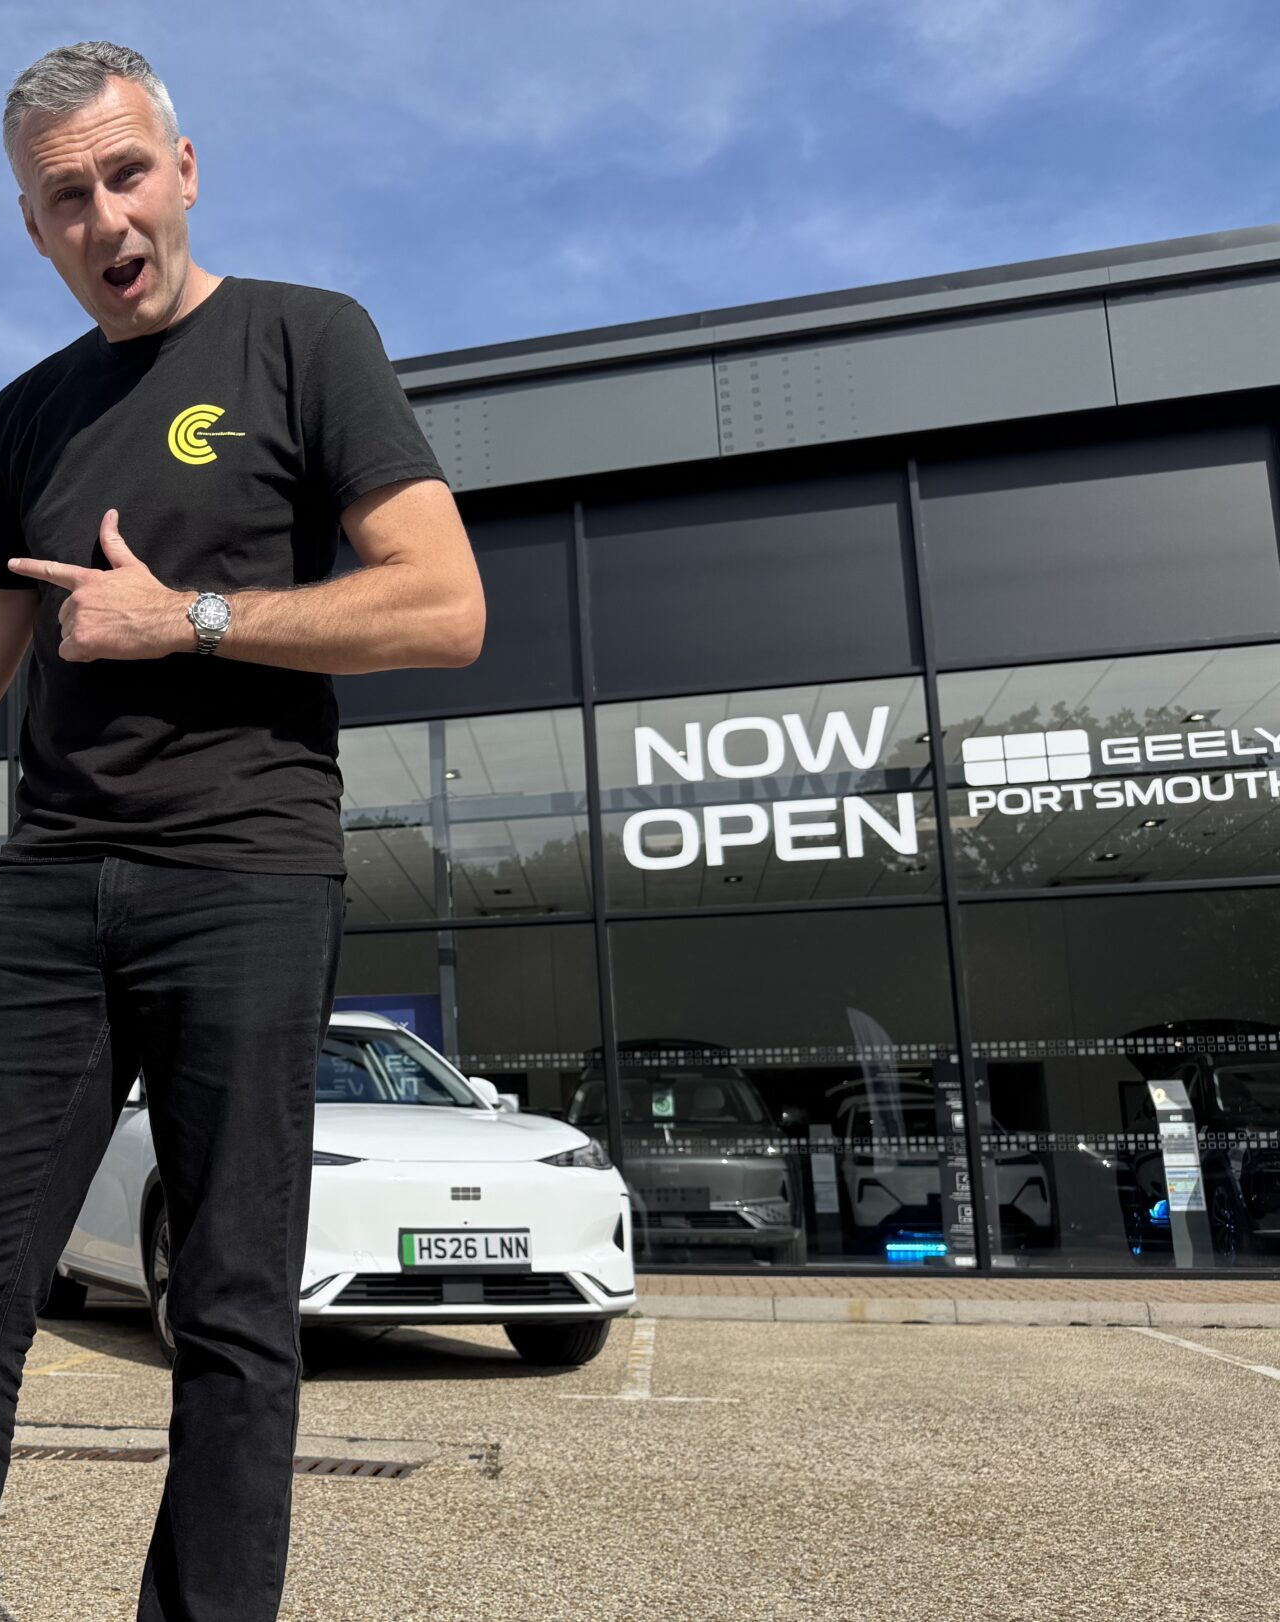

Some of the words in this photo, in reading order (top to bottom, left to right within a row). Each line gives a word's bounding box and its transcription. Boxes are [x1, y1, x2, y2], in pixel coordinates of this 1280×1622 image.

[635, 706, 889, 786] NOW
[623, 792, 918, 870] OPEN
[418, 1237, 477, 1259] HS26
[484, 1236, 529, 1259] LNN
